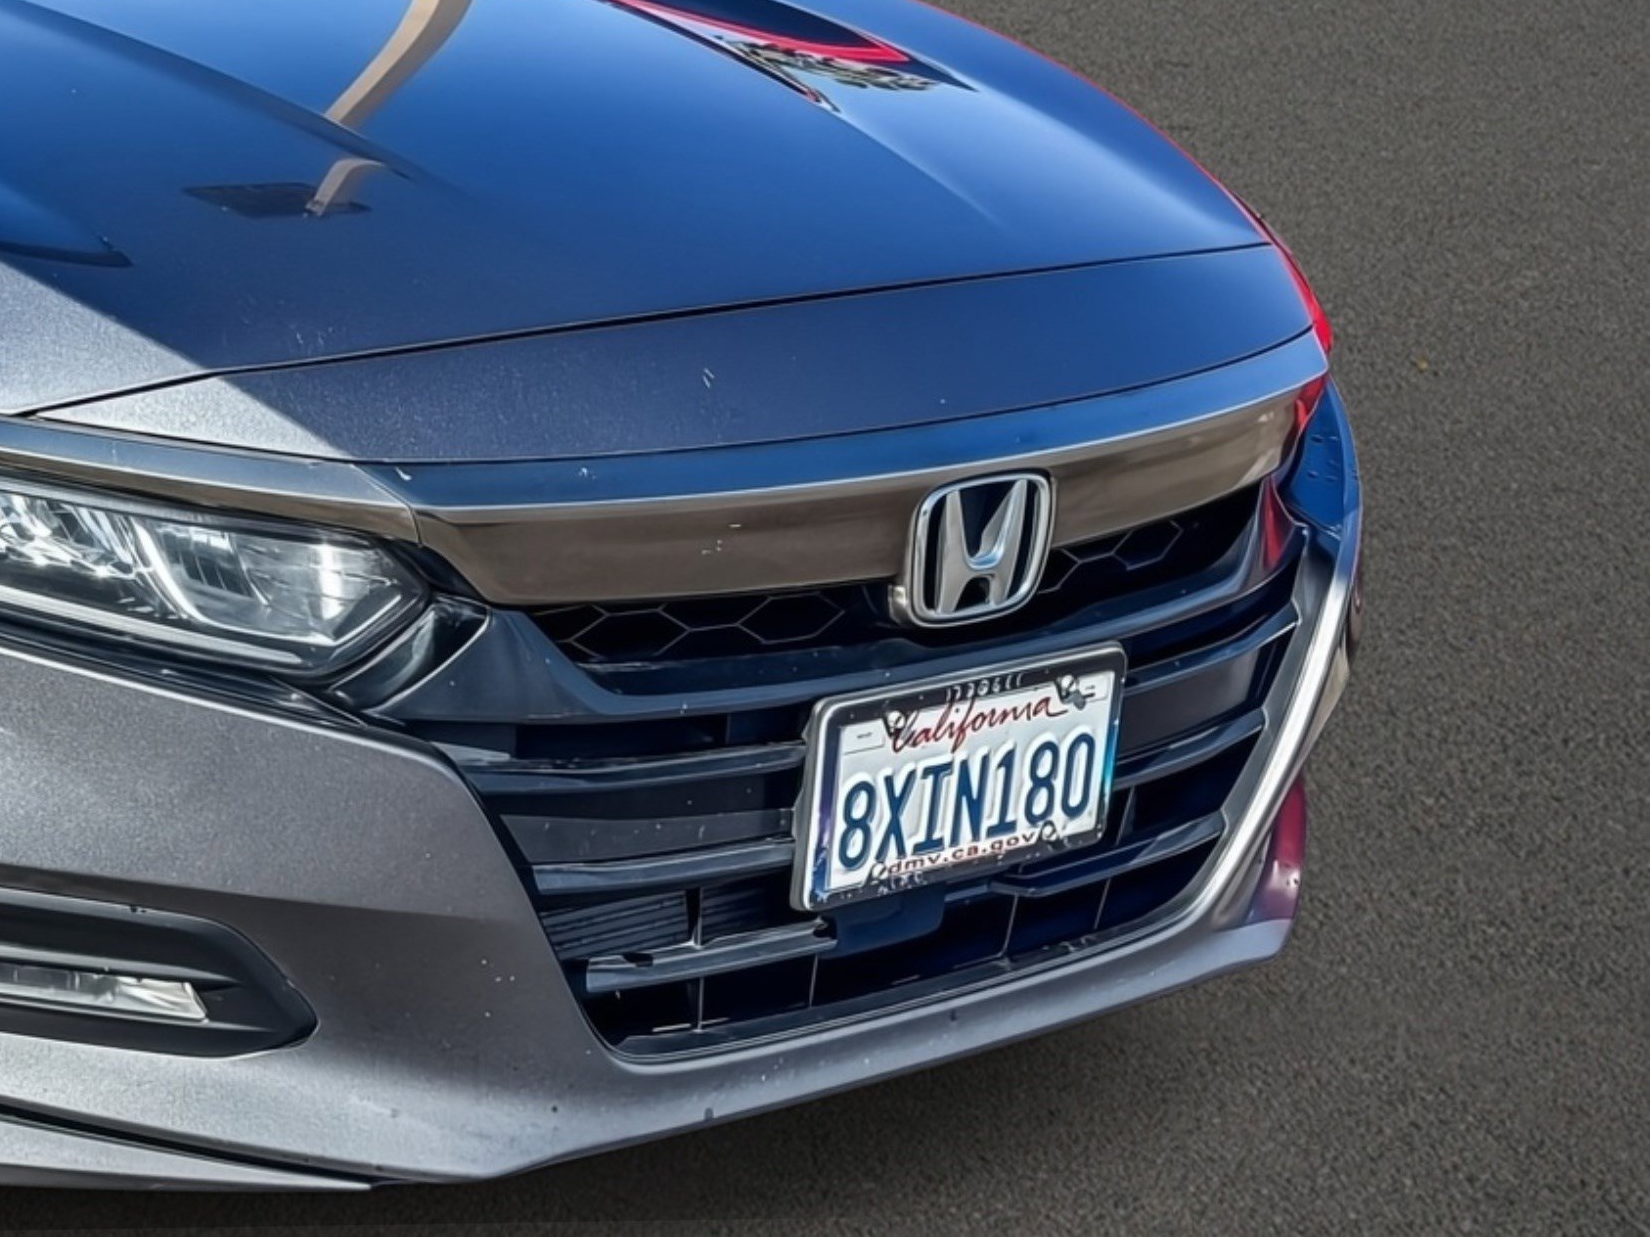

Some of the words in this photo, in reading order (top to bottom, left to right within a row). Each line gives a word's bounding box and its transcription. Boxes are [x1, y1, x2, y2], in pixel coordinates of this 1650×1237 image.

[891, 694, 1069, 754] California
[838, 731, 1096, 871] 8XIN180
[888, 831, 1036, 875] dmv.ca.gov
